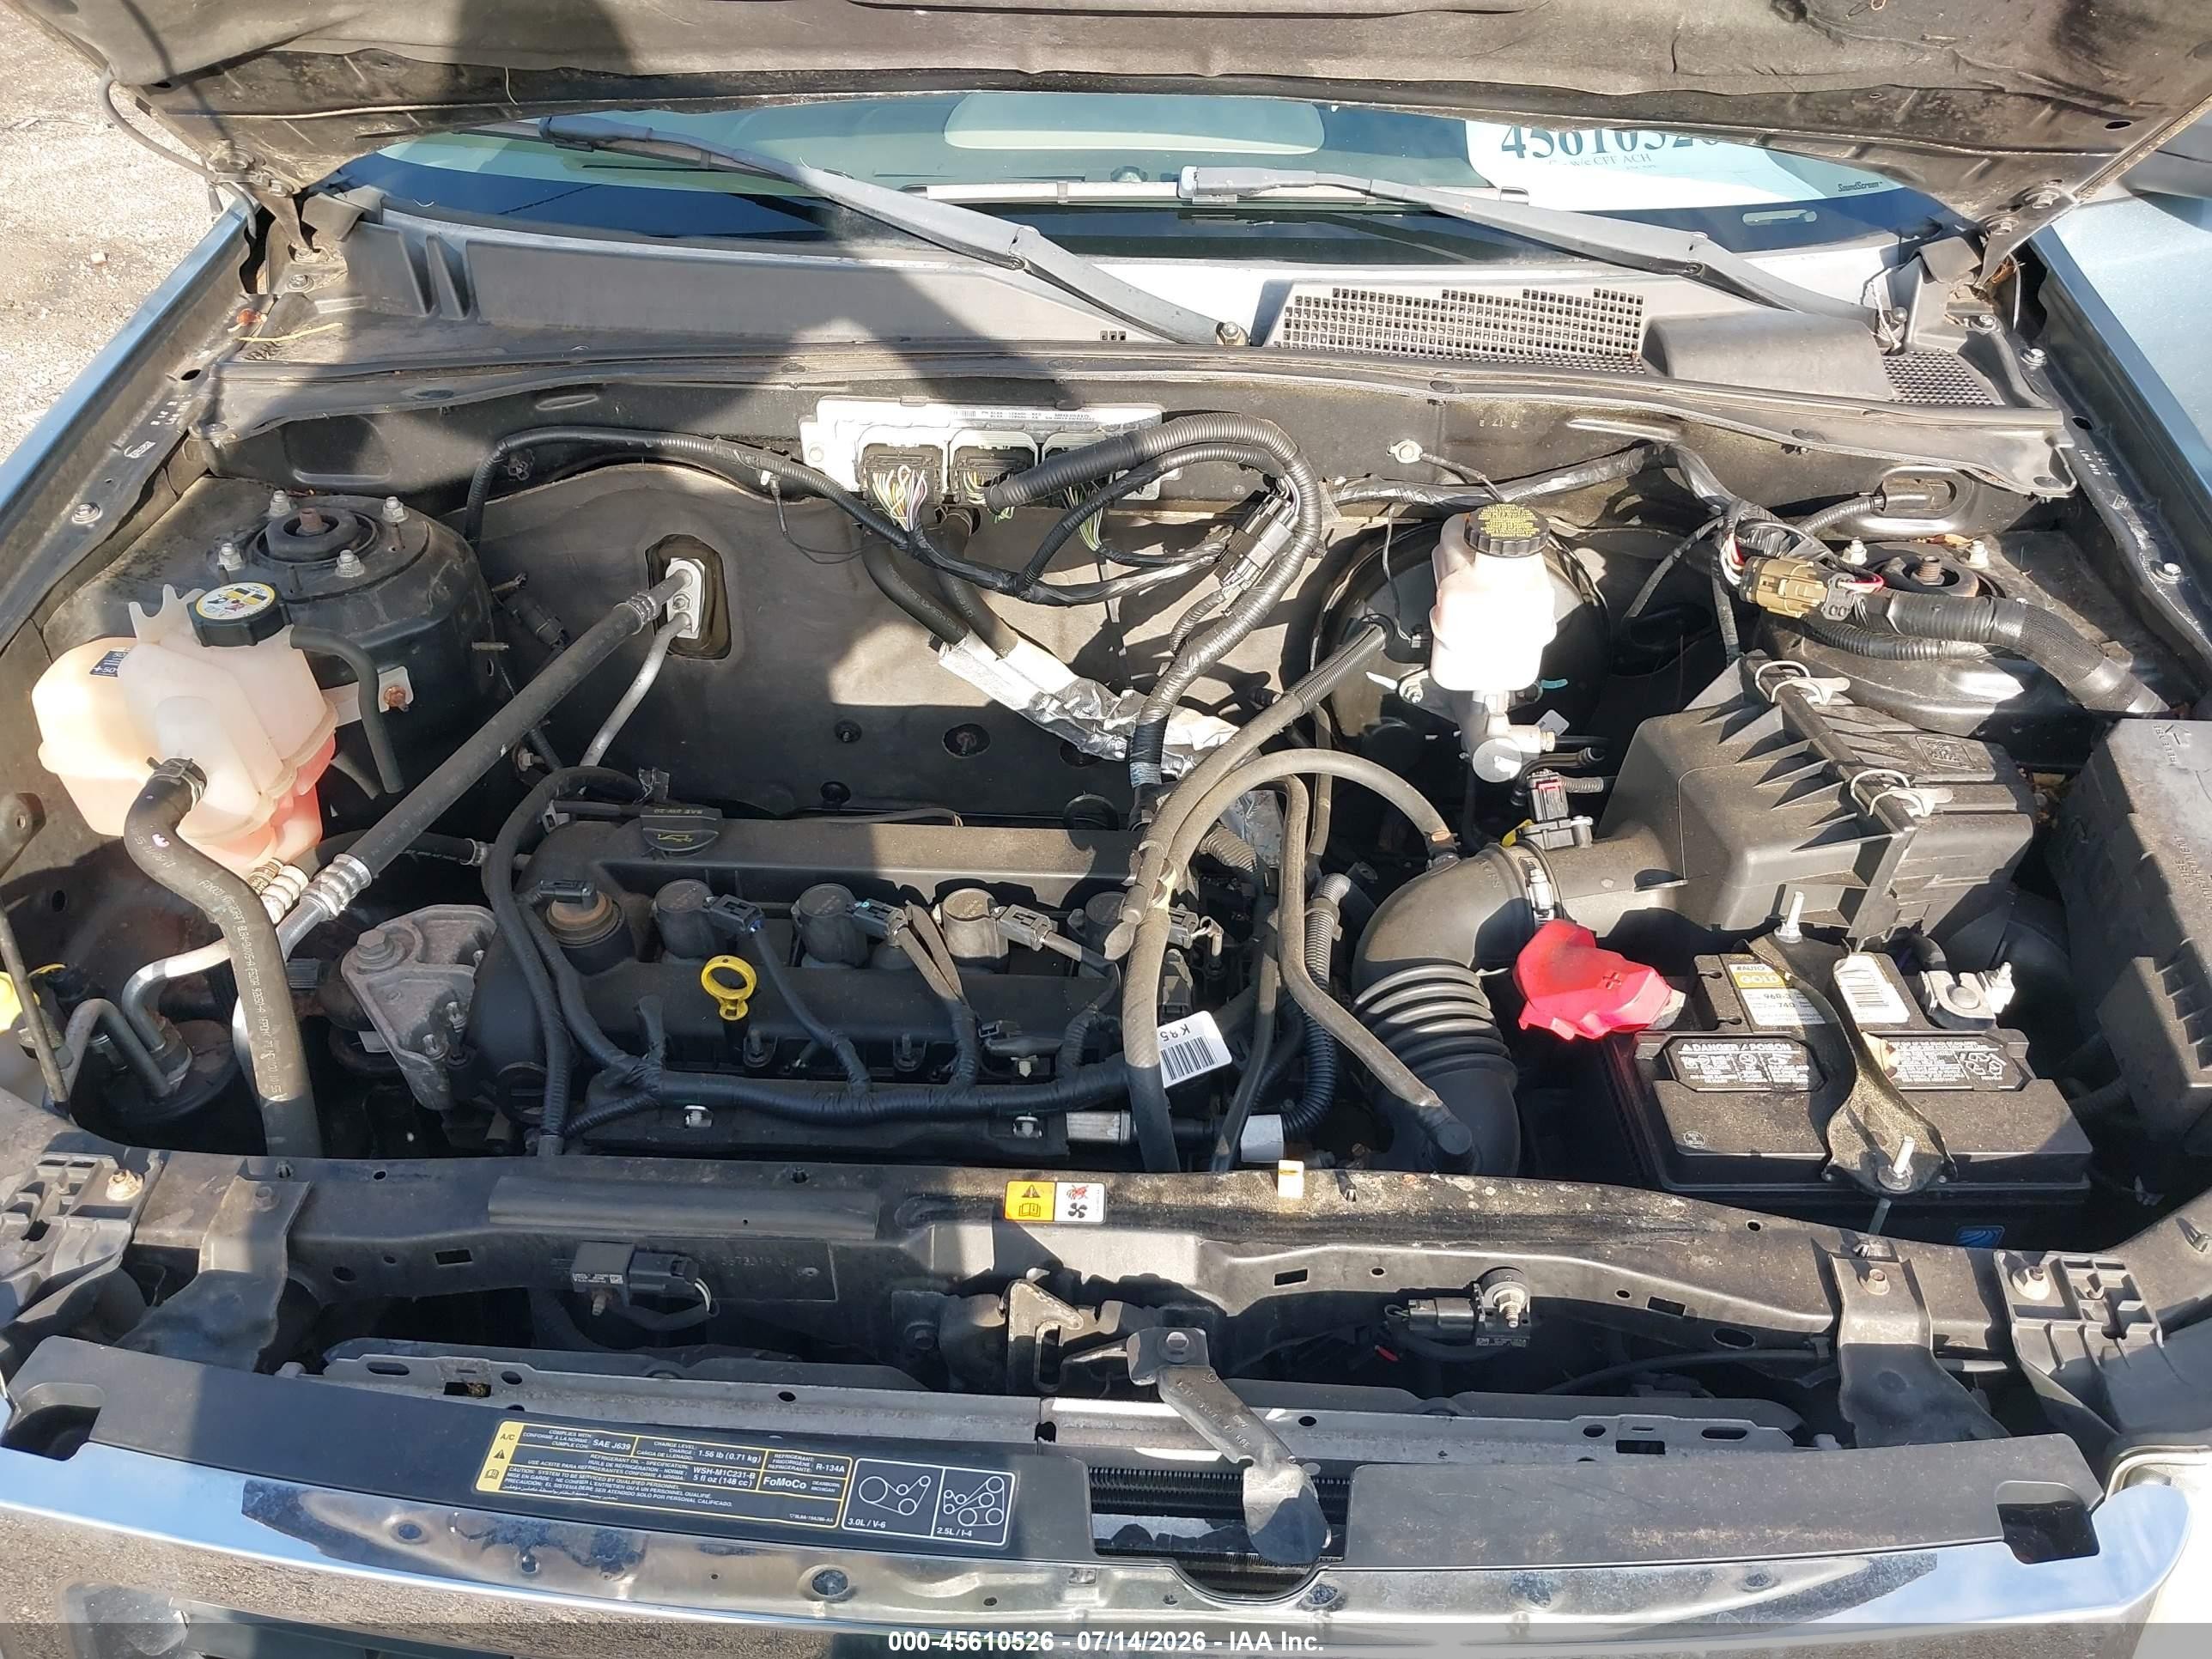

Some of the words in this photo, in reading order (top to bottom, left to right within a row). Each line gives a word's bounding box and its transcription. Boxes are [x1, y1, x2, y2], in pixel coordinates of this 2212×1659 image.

[592, 1439, 610, 1448] SAE
[611, 1441, 631, 1450] J639
[725, 1452, 744, 1461] (0.71
[747, 1454, 762, 1463] kg)
[693, 1467, 757, 1479] WSH-M1C231-B
[816, 1462, 845, 1473] R-134A
[719, 1476, 737, 1485] (148
[738, 1479, 753, 1487] cc)
[763, 1476, 807, 1489] FoMoCo
[847, 1517, 866, 1527] 3.0L
[872, 1520, 886, 1528] V-6
[936, 1526, 956, 1536] 2.5L
